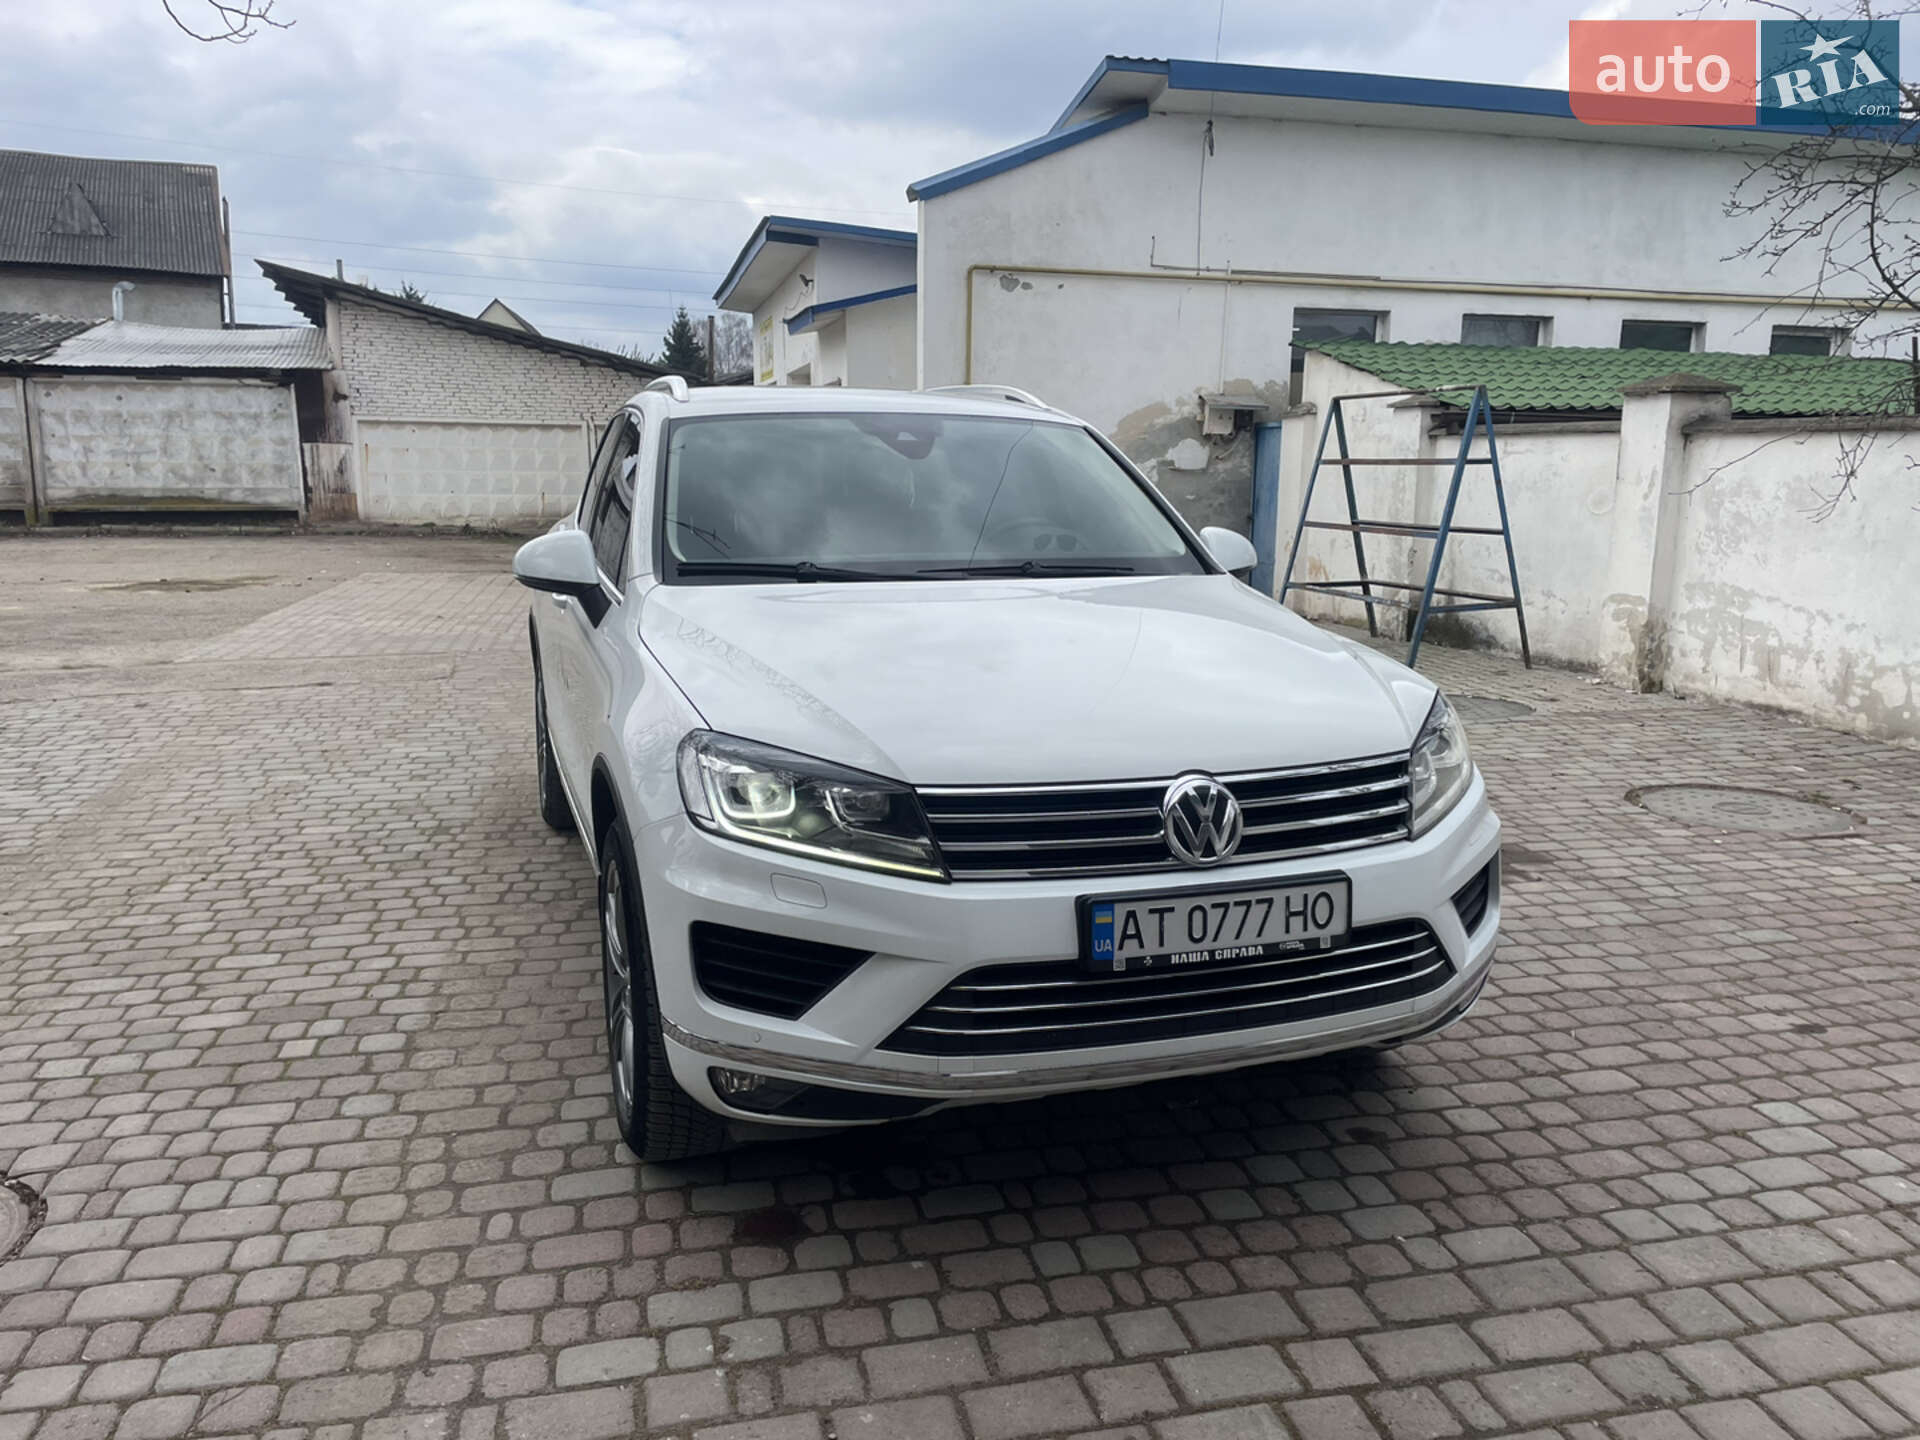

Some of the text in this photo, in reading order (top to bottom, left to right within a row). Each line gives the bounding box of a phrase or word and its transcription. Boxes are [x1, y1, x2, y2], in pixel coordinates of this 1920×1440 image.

[1116, 890, 1335, 951] AT 0777 HO
[1094, 939, 1113, 953] UA
[1170, 950, 1210, 964] НАША
